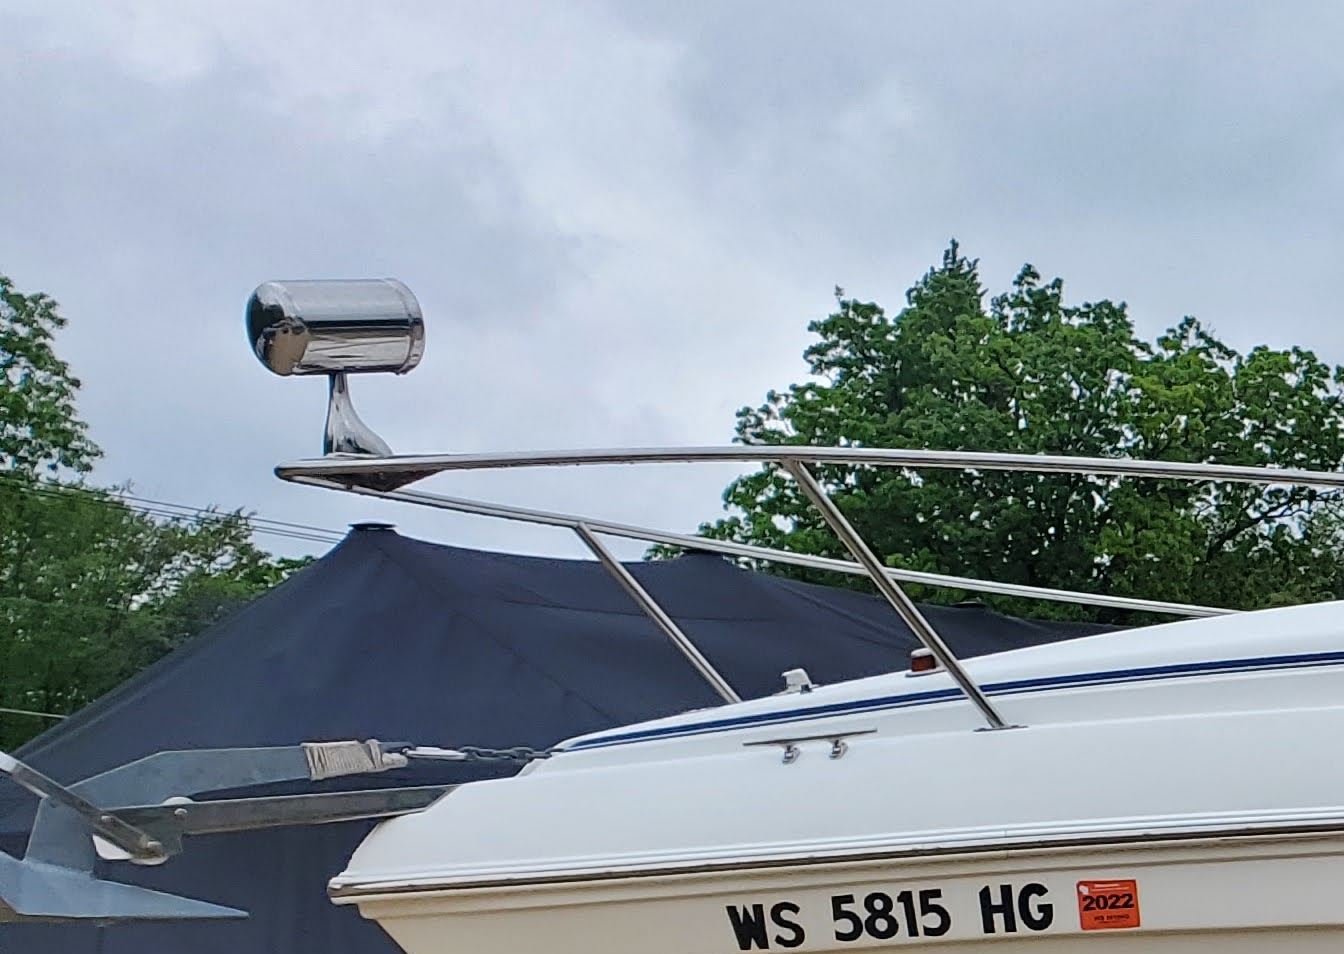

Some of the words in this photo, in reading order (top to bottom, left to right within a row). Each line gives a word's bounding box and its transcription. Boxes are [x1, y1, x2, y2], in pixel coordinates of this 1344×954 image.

[726, 901, 805, 950] WS
[831, 889, 951, 941] 5815
[979, 883, 1053, 933] HG
[1082, 893, 1134, 911] 2022
